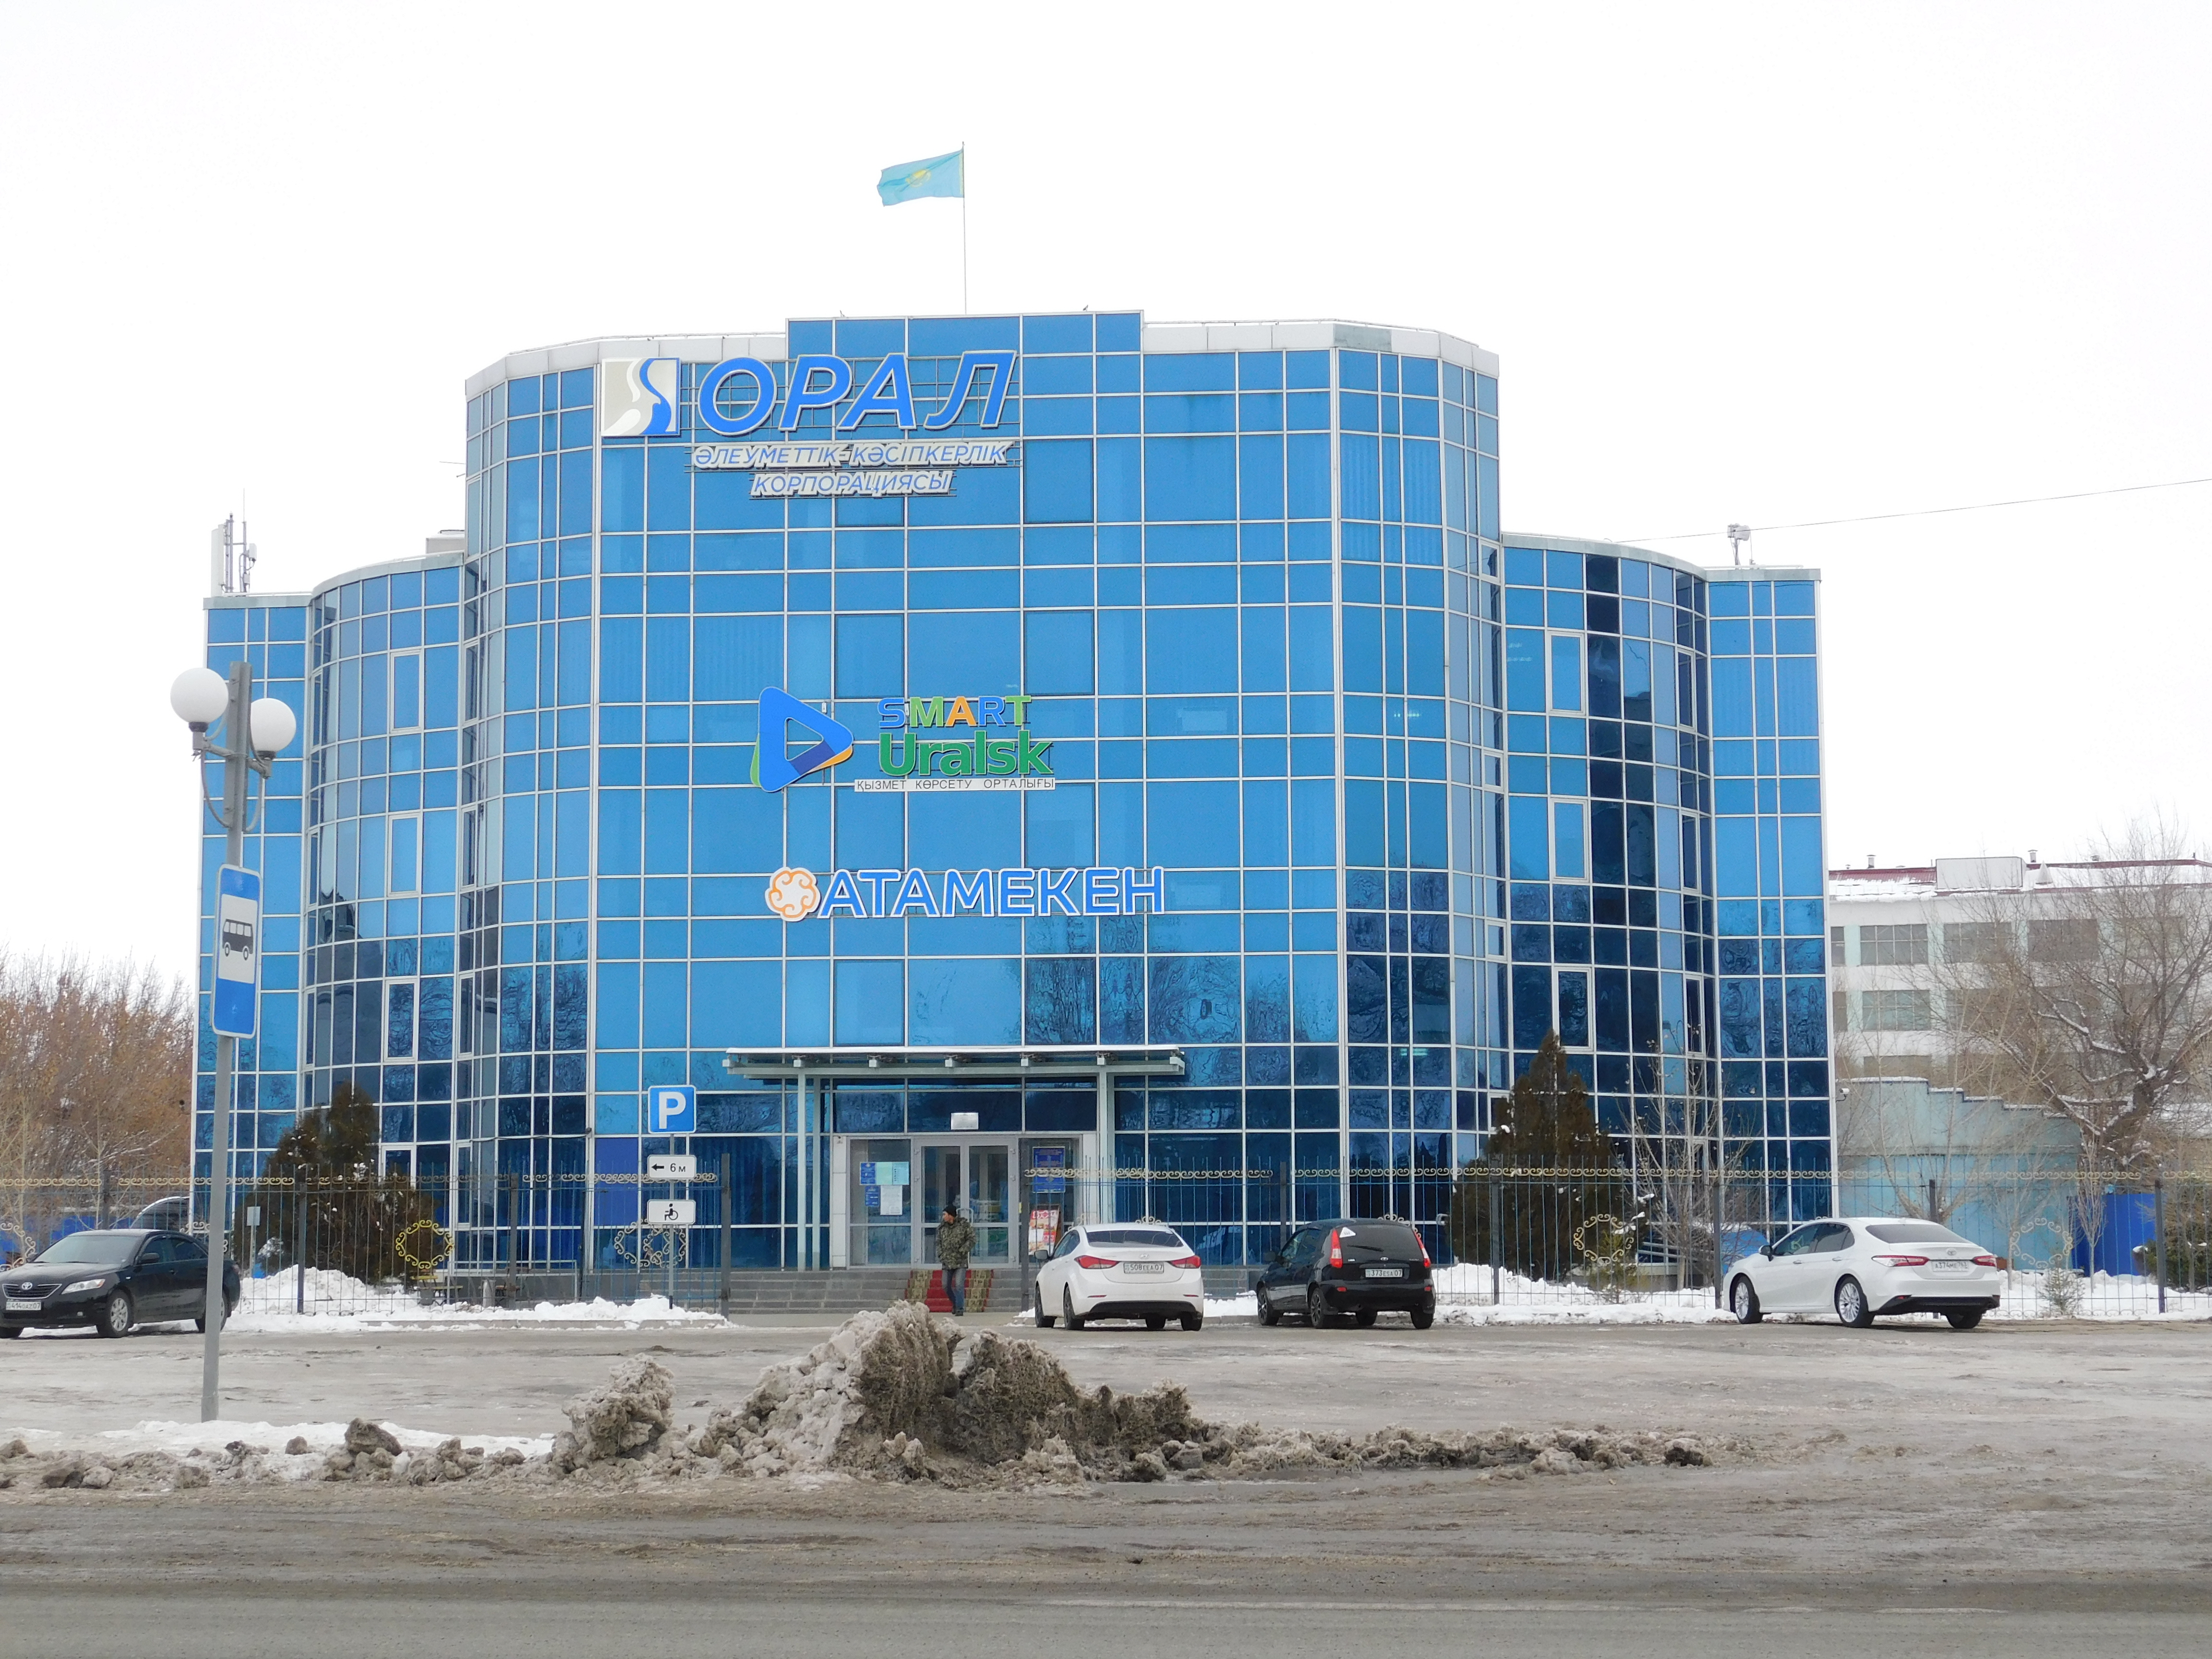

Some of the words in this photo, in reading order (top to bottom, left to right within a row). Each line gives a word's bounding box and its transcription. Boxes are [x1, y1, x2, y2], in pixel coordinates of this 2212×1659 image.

[698, 350, 1017, 436] ОРАЛ
[694, 443, 1008, 469] ӘЛЕУМЕТТІК-КӘСІПКЕРЛІК
[753, 472, 952, 496] КОРПОРАЦИЯСЫ
[878, 695, 1032, 728] SMART
[879, 730, 1053, 776] Uralsk
[857, 781, 907, 792] ҚЫЗМЕТ
[915, 780, 972, 789] КӨРСЕТУ
[984, 779, 1054, 789] ОРТАЛЫҒЫ
[817, 866, 1165, 918] АТАМЕКЕН
[659, 1092, 686, 1129] P
[670, 1163, 676, 1172] 6
